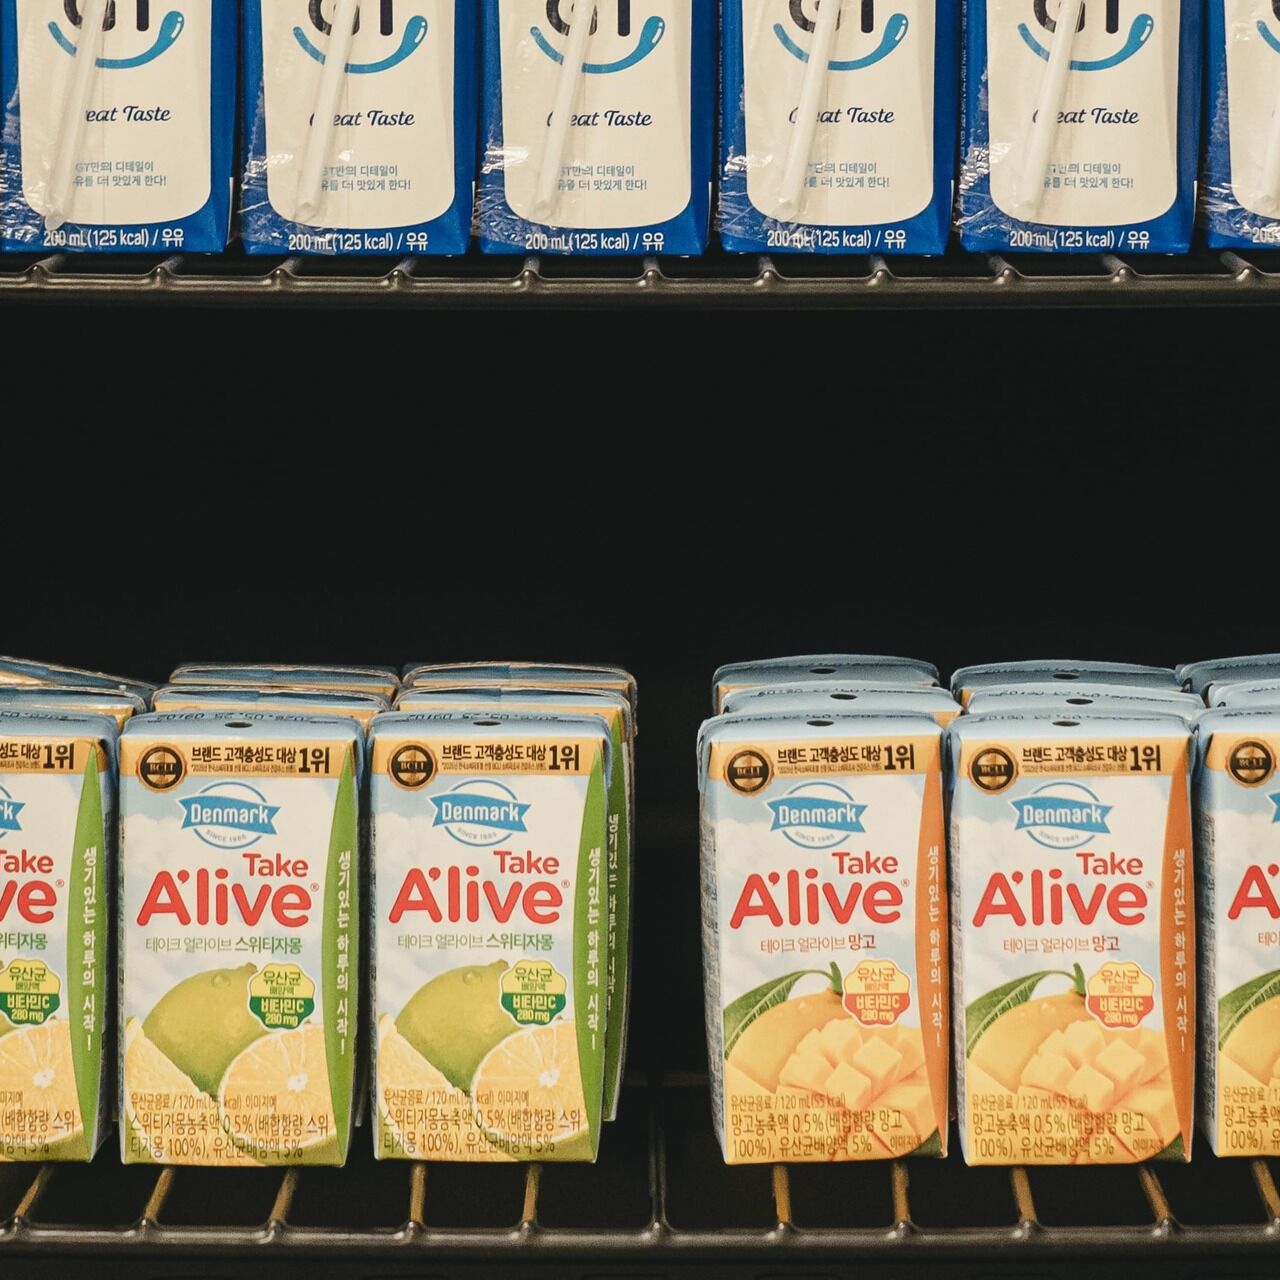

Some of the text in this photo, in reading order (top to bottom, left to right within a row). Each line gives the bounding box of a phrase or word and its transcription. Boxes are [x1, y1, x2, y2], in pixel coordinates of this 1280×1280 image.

[123, 105, 171, 122] Taste
[367, 110, 415, 126] Taste
[604, 110, 652, 126] Taste
[847, 107, 895, 123] Taste
[1091, 107, 1139, 124] Taste
[115, 161, 153, 173] 디테일이
[99, 175, 167, 187] 더 맛있게 한다!
[120, 228, 149, 247] kcal)
[162, 228, 184, 247] 우유
[288, 232, 428, 251] 200 kcal) 우유
[525, 234, 548, 250] 200
[601, 232, 630, 250] kcal)
[642, 232, 664, 251] 우유
[767, 230, 906, 248] 200 kcal) 우유
[1010, 231, 1032, 246] 200
[1086, 231, 1115, 248] kcal)
[1128, 231, 1150, 249] 우유
[21, 743, 40, 759] 대상
[43, 743, 74, 769] 1위
[192, 746, 221, 762] 브랜드
[224, 746, 273, 762] 고객충성도
[276, 746, 296, 763] 대상
[298, 747, 330, 773] 1위
[442, 744, 472, 761] 브랜드
[475, 744, 524, 761] 고객충성도
[526, 744, 546, 761] 대상
[548, 744, 579, 771] 1위
[778, 748, 807, 764] 브랜드
[861, 745, 881, 762] 대상
[884, 744, 915, 770] 1위
[1023, 746, 1052, 762] 브랜드
[1107, 745, 1127, 762] 대상
[1130, 745, 1161, 771] 1위
[191, 804, 268, 824] Denmark
[442, 802, 519, 821] Denmark
[779, 805, 857, 824] Denmark
[1023, 805, 1101, 824] Denmark
[243, 853, 308, 877] Take
[493, 850, 559, 875] Take
[832, 851, 898, 874] Take
[1076, 852, 1143, 876] Take
[83, 847, 97, 924] 생기있는
[928, 846, 940, 922] 생기있는
[146, 937, 302, 954] 테이크 얼라이브 스위티자몽
[398, 933, 554, 951] 테이크 얼라이브 스위티자몽
[760, 934, 877, 953] 테이크 얼라이브 망고
[1003, 935, 1120, 953] 테이크 얼라이브 망고
[83, 934, 96, 988] 하루의
[929, 930, 941, 985] 하루의
